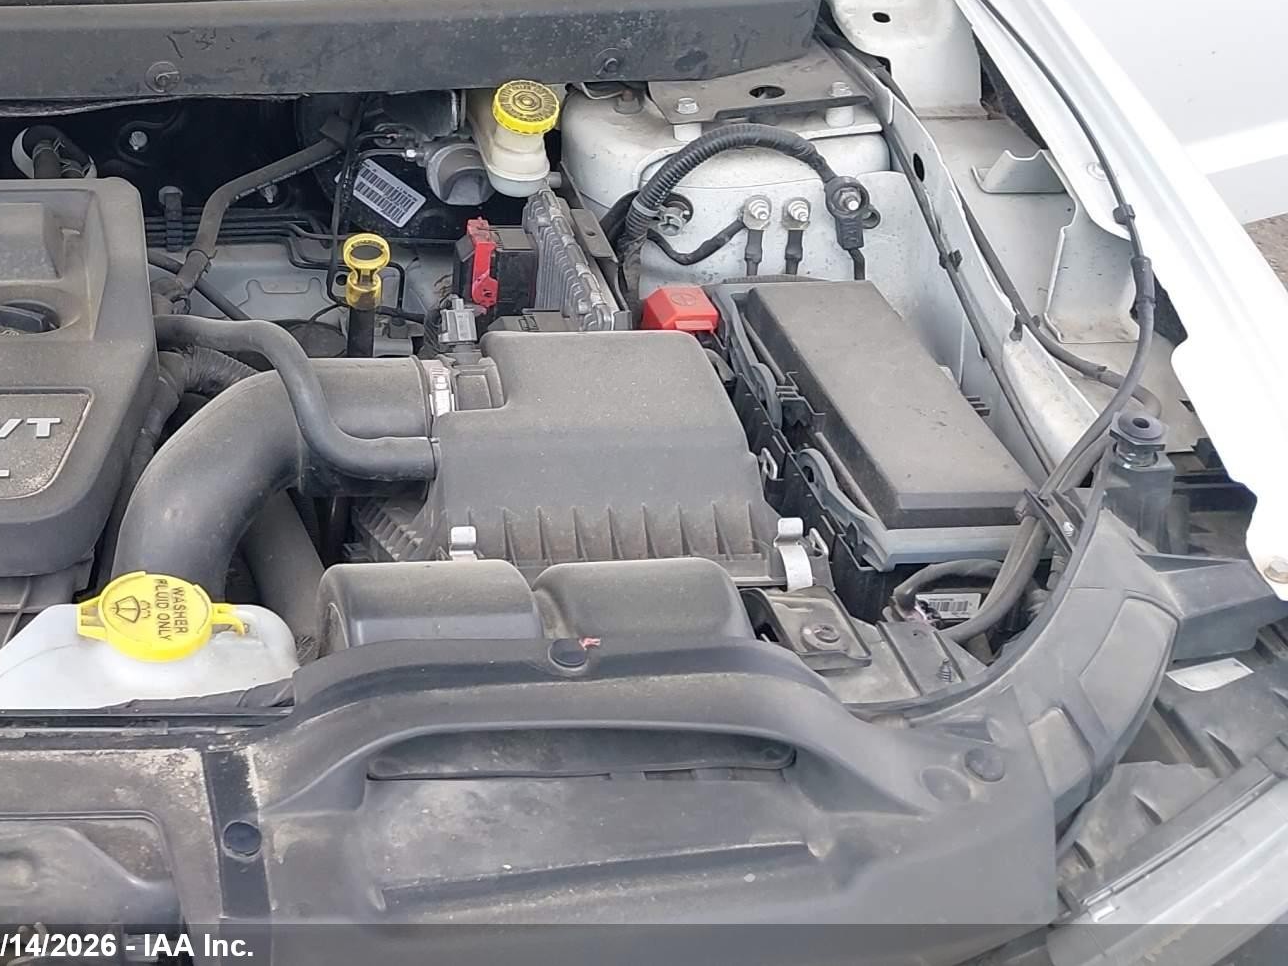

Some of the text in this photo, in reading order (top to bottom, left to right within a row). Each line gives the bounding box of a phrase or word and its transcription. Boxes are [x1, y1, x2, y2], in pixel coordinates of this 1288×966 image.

[155, 578, 173, 641] FLUID ONLY
[172, 586, 188, 634] WASHER
